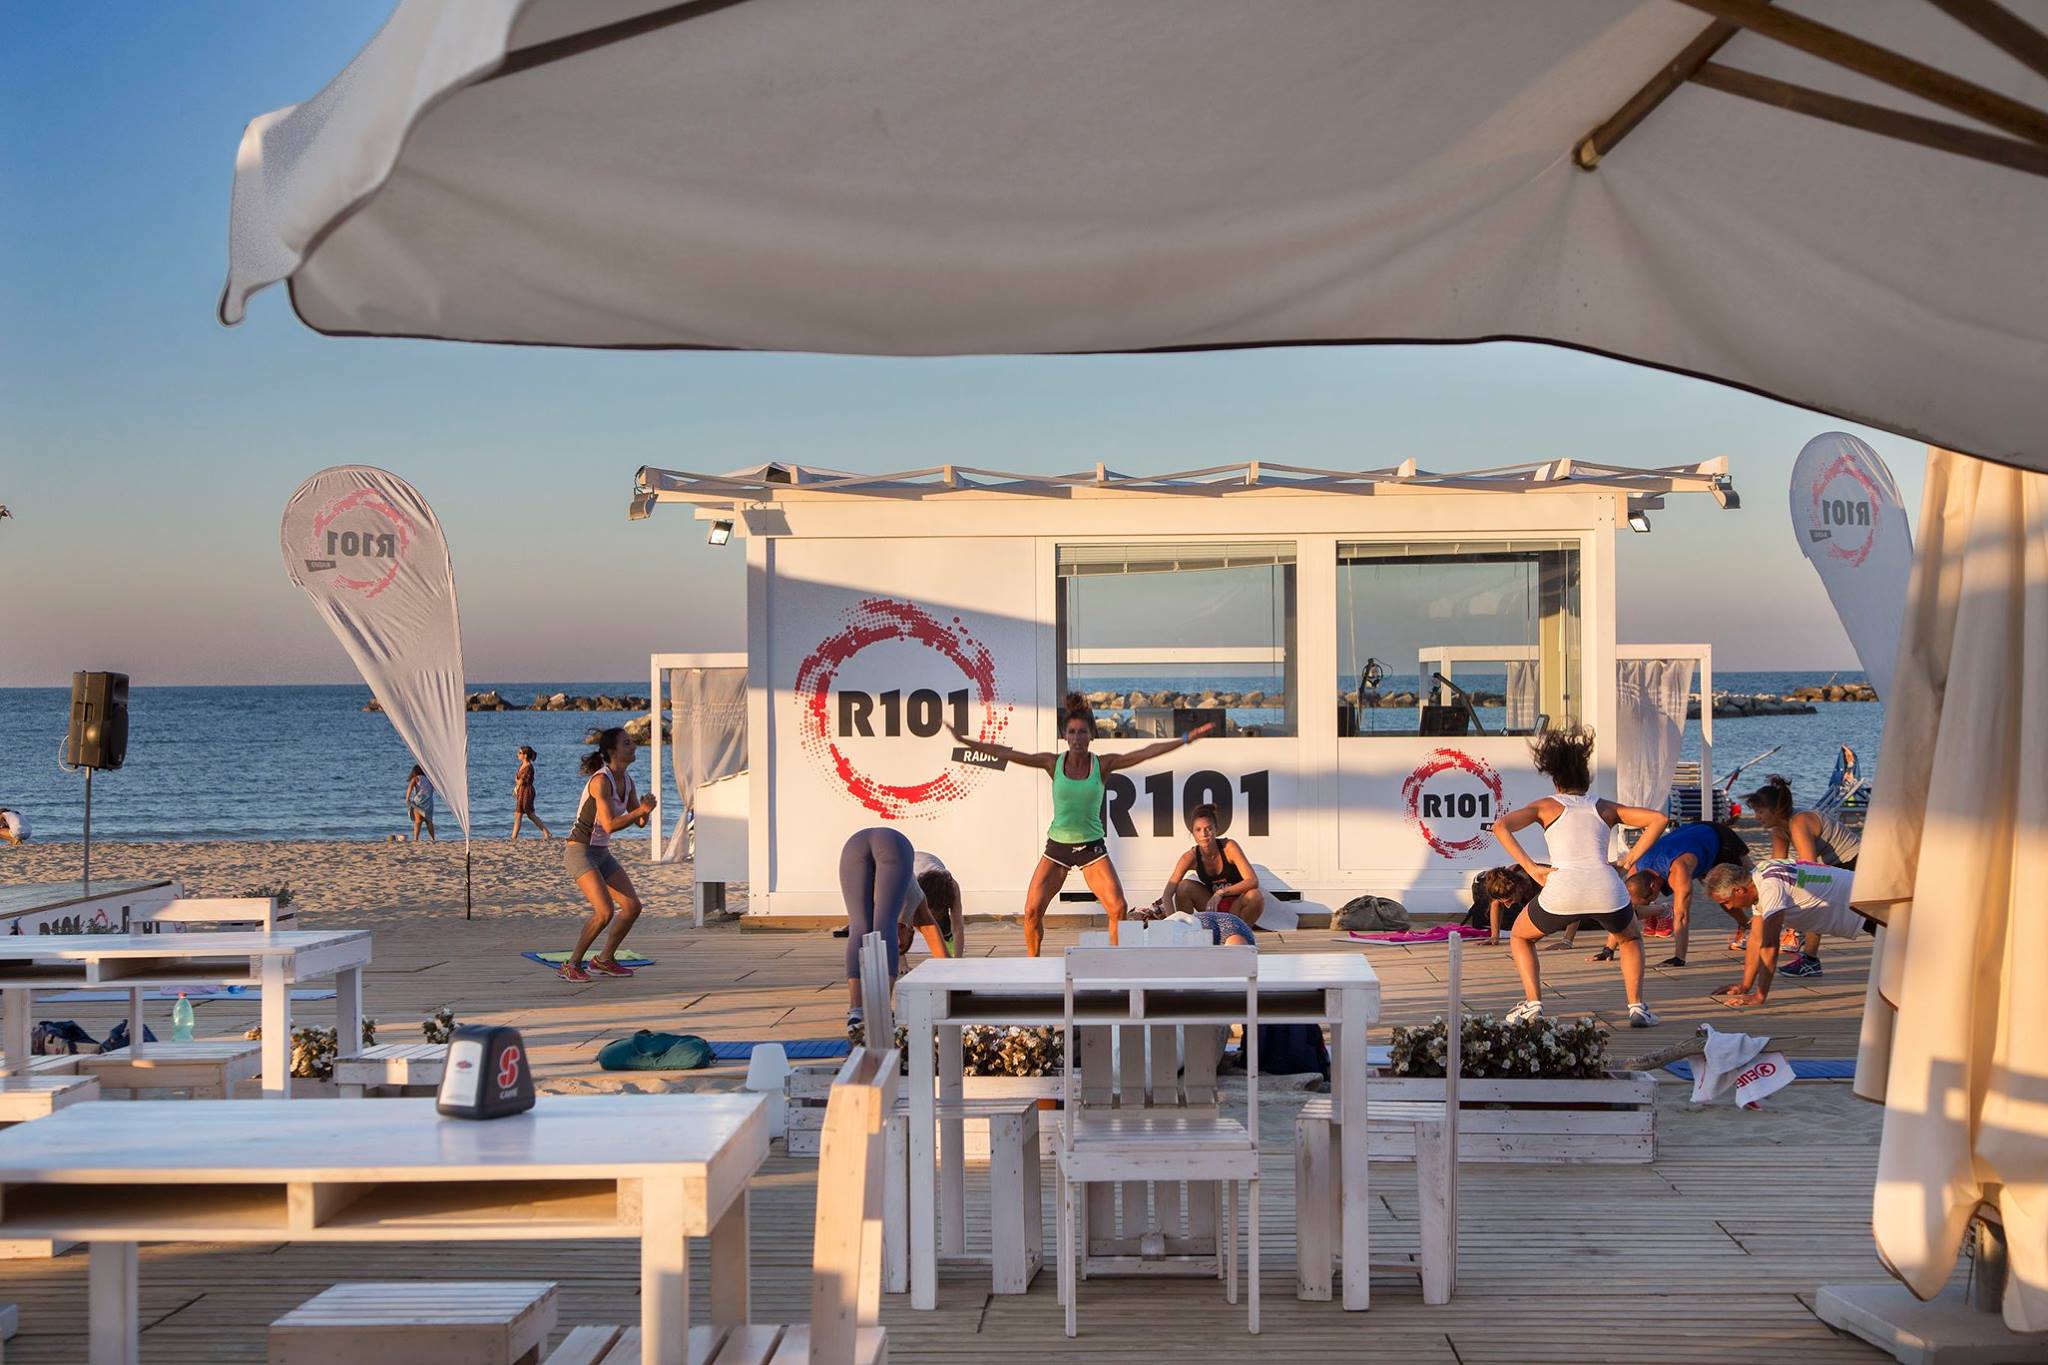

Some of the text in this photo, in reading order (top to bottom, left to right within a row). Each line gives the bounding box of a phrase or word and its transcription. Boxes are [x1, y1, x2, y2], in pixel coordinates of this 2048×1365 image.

[838, 688, 969, 737] R101
[1103, 770, 1269, 837] R101
[1423, 793, 1490, 818] R101
